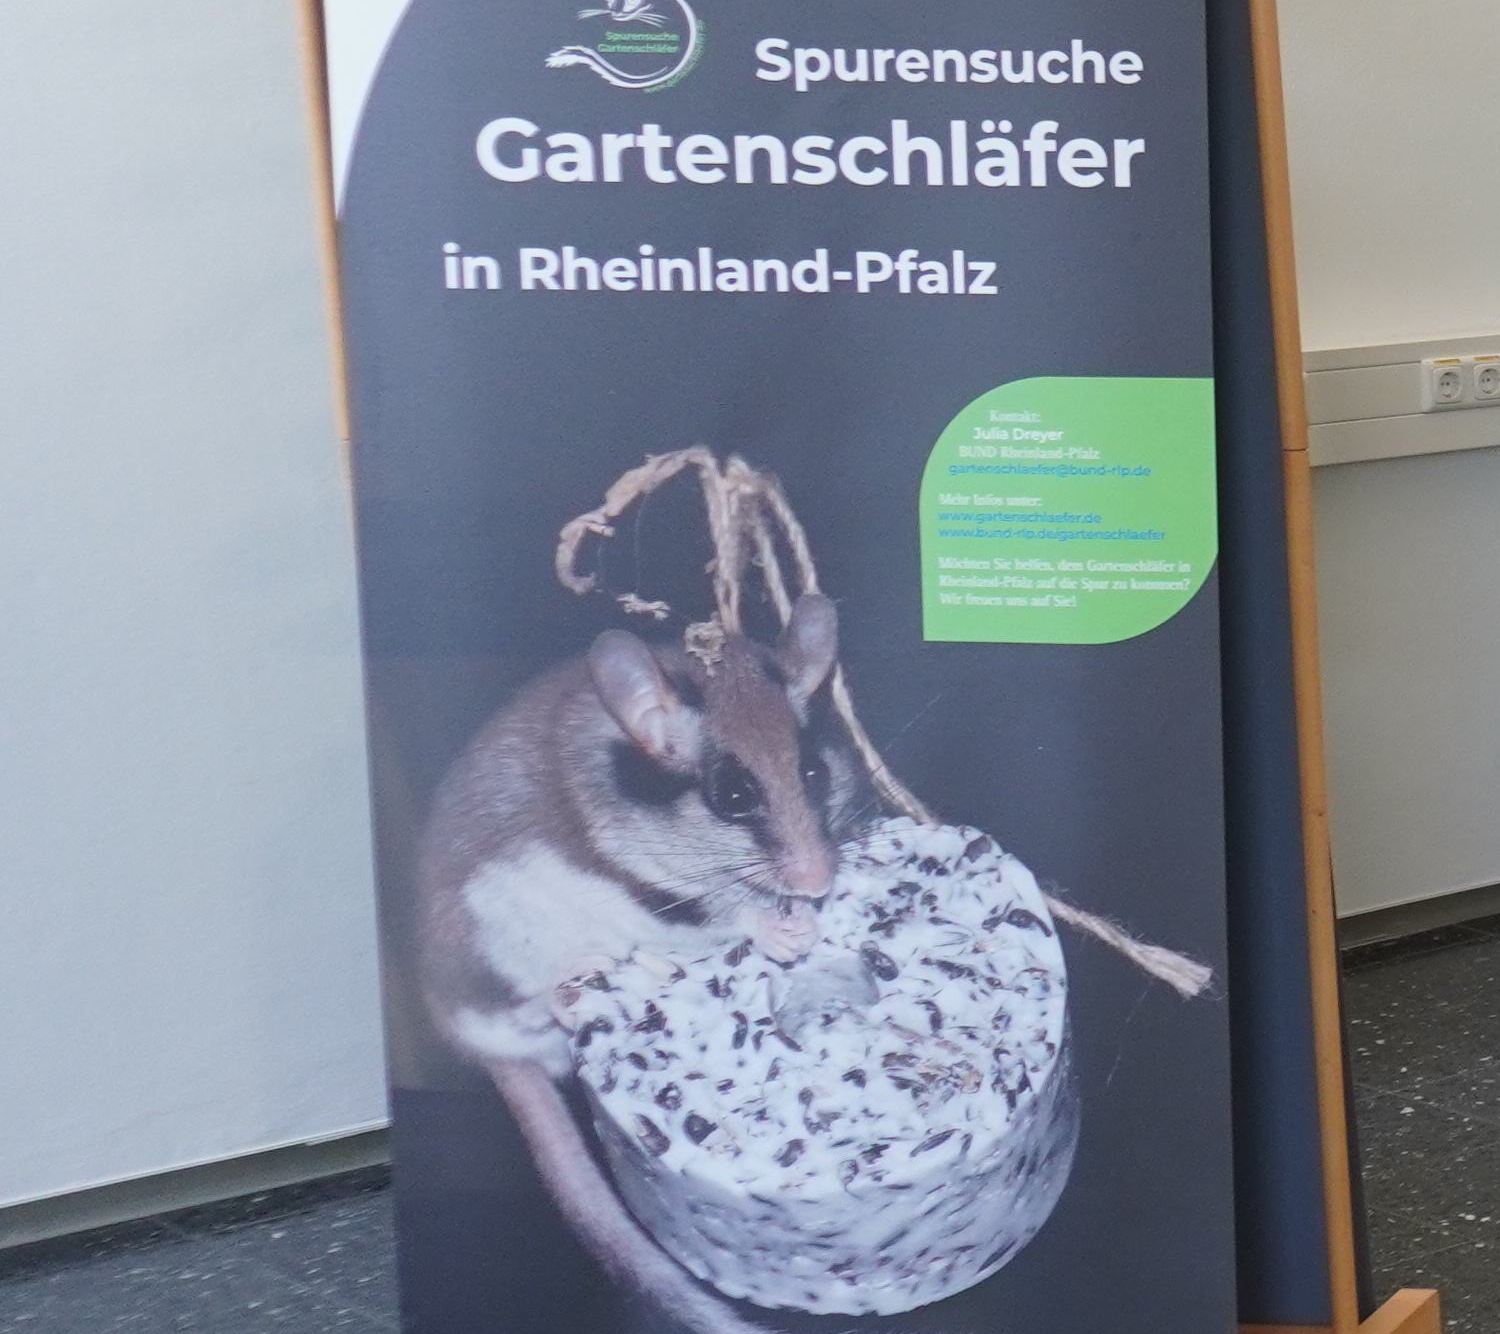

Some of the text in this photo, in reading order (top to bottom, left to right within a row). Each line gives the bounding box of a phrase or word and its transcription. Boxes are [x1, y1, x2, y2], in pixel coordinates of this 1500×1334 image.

[754, 37, 1144, 92] Spurensuche
[476, 117, 1146, 188] Gartenschläfer
[443, 243, 998, 296] in Rheinland-Pfalz
[958, 446, 1101, 459] BUND Rheinland-Pfalz
[973, 427, 1065, 443] Julia Dreyer
